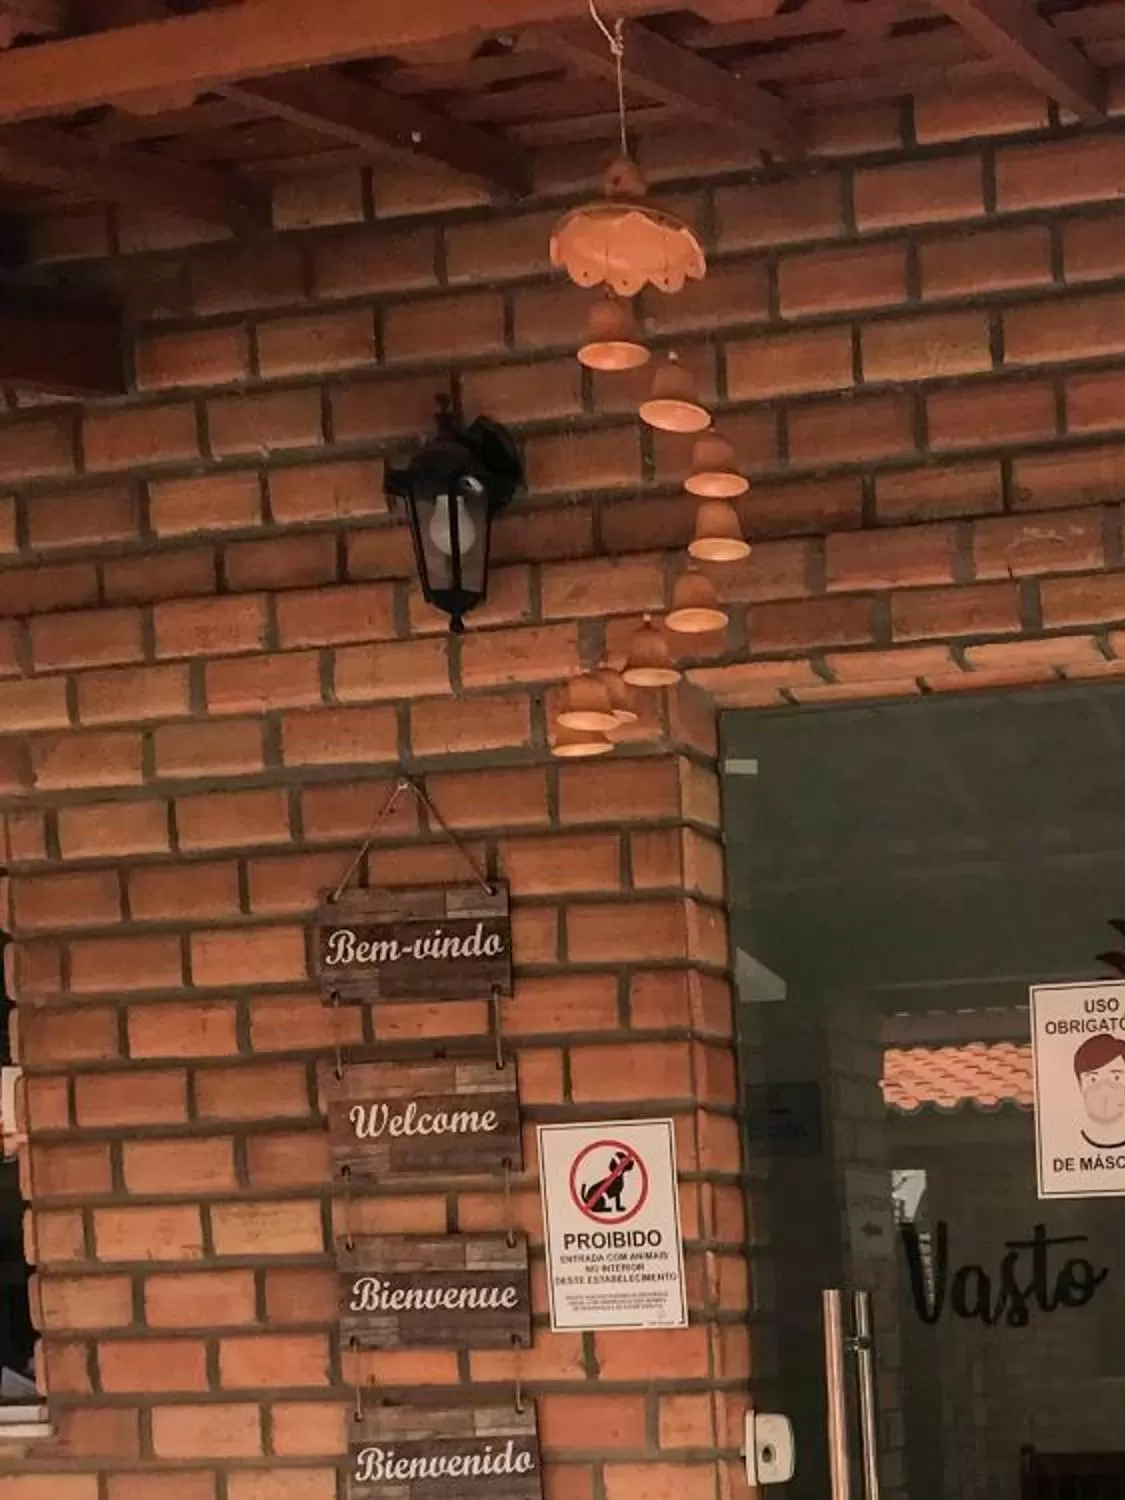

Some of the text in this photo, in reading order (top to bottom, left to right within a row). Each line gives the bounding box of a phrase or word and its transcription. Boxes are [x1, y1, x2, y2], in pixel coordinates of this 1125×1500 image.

[325, 923, 504, 966] Bem-vindo
[1084, 997, 1120, 1014] USO
[349, 1103, 500, 1140] Welcome
[1053, 1157, 1076, 1173] DE
[563, 1229, 663, 1250] PROIBIDO
[606, 1252, 628, 1261] COM
[898, 1220, 1107, 1326] Vasto
[349, 1277, 519, 1312] Bienvenue
[354, 1439, 535, 1482] Bienvenido
